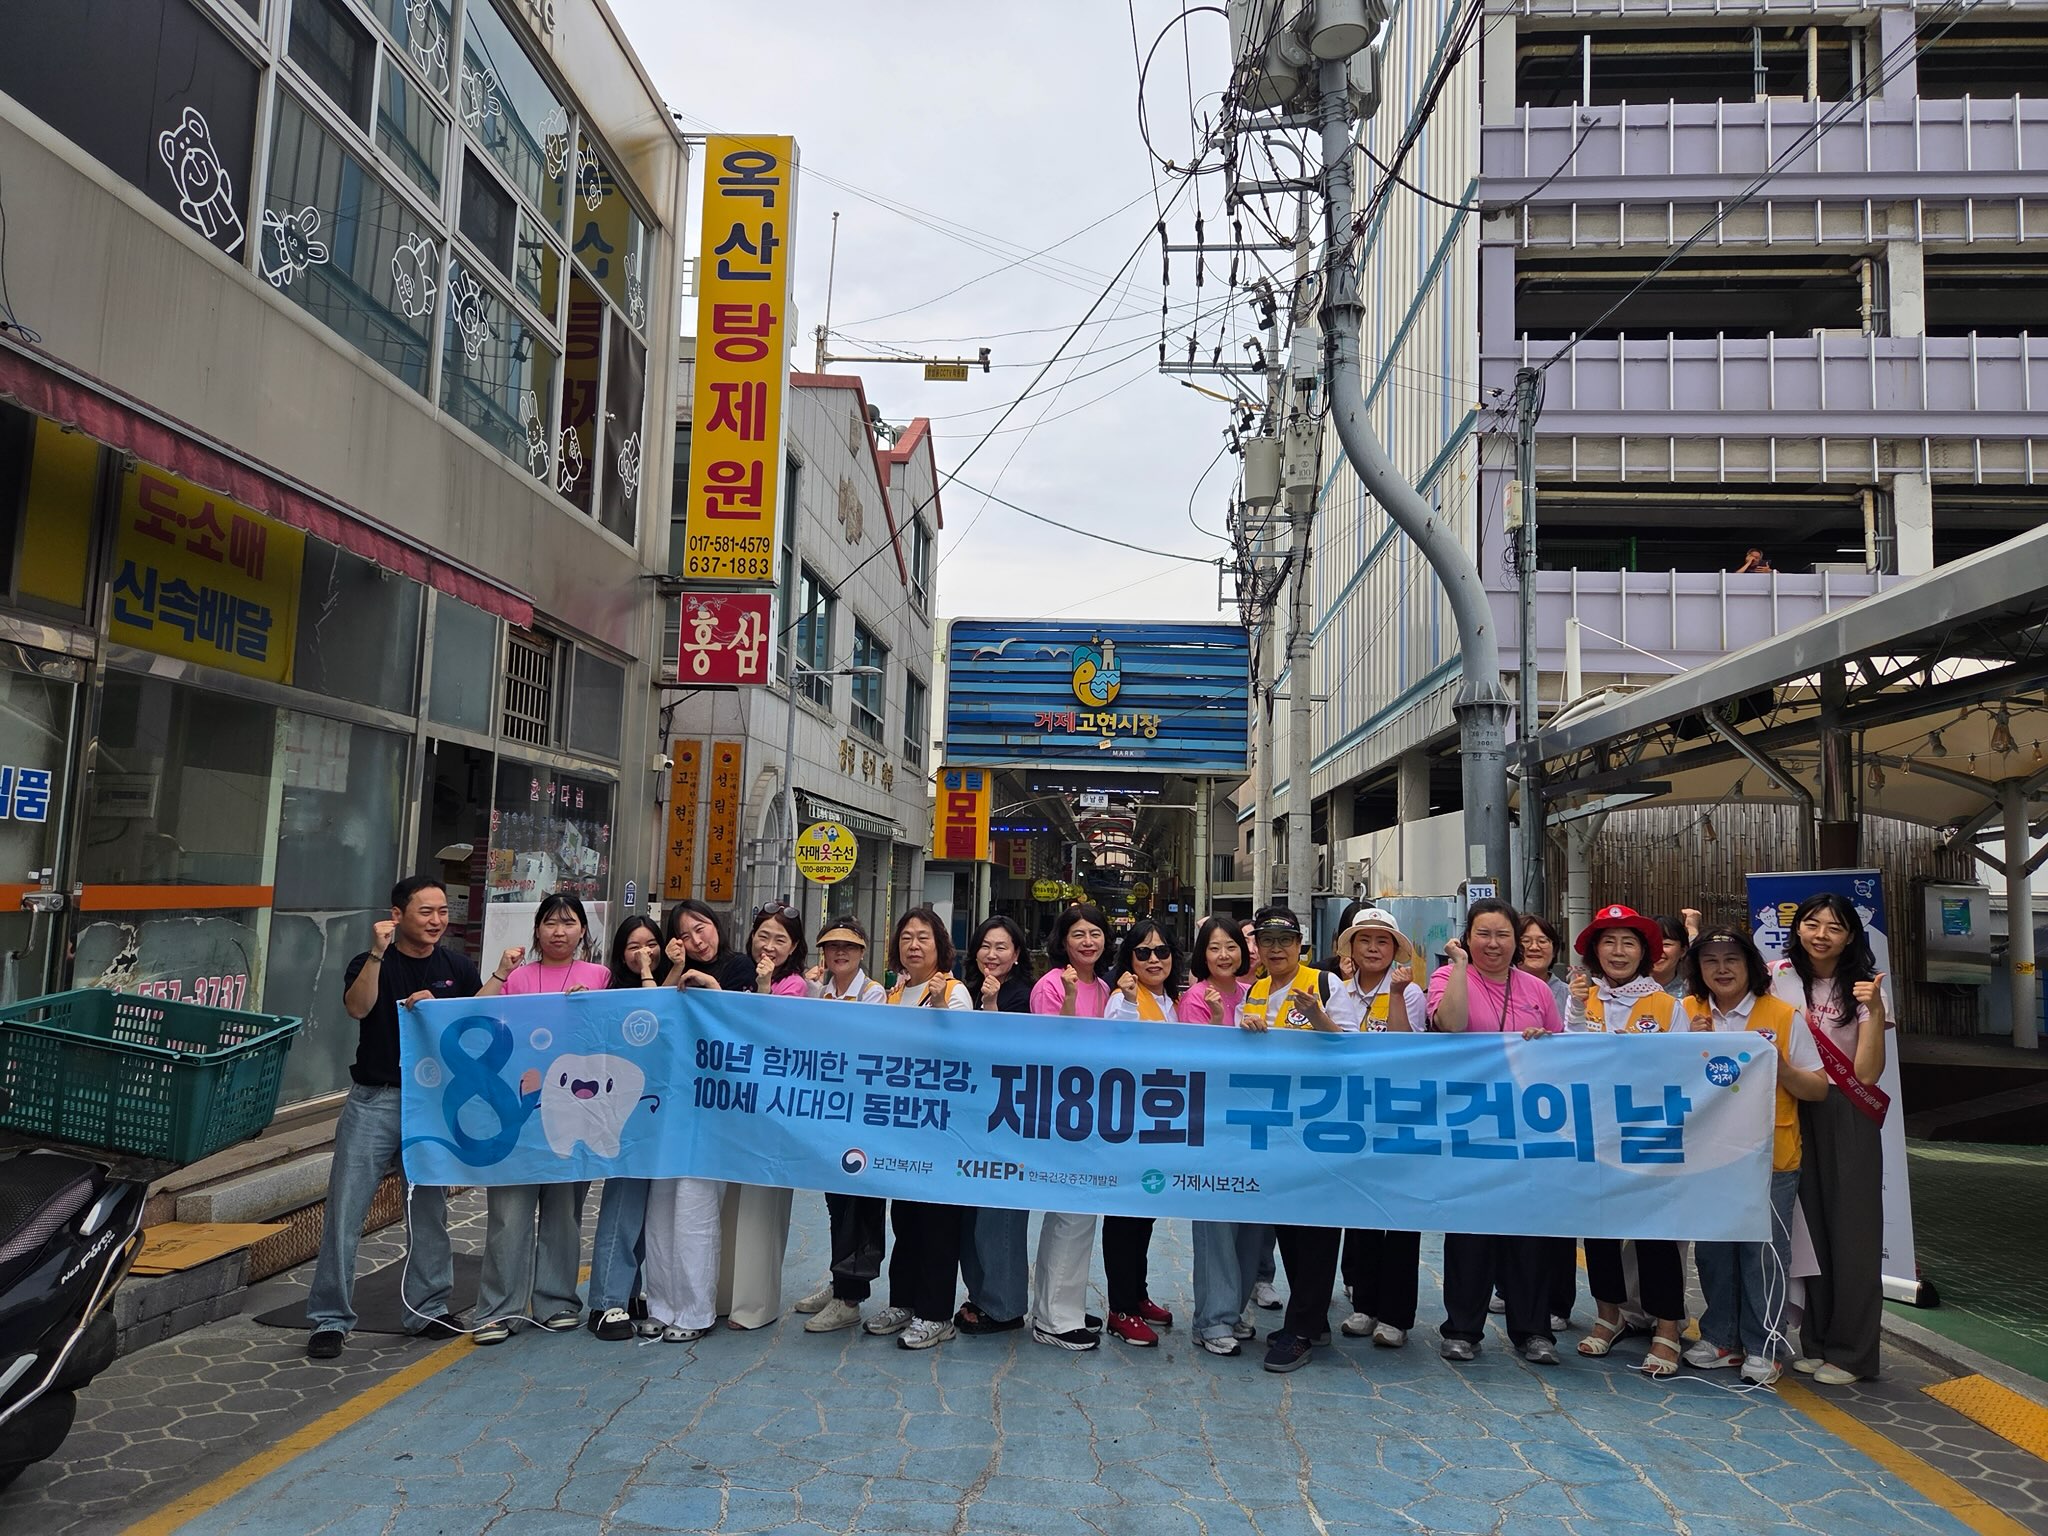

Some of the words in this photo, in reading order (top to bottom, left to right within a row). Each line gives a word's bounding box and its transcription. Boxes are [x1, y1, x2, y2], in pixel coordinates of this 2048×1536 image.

[703, 150, 780, 520] 옥산탕제원
[689, 535, 770, 554] 017-581-4579
[689, 556, 769, 575] 637-1883
[113, 559, 273, 663] 신속배달
[683, 611, 767, 678] 홍삼
[1034, 711, 1162, 739] 거제고현시장
[0, 765, 52, 823] 품
[944, 770, 983, 791] 성림
[669, 772, 689, 891] 고현분회
[709, 773, 728, 894] 성림경로당
[945, 792, 977, 860] 모텔
[798, 844, 854, 861] 자매옷수선
[802, 865, 849, 874] 010-8878-2043
[627, 893, 634, 904] 22
[1469, 887, 1492, 897] STB
[695, 1039, 754, 1073] 80년
[763, 1045, 848, 1083] 함께한
[856, 1054, 978, 1094] 구강건강,
[693, 1077, 759, 1114] 100세
[766, 1086, 854, 1123] 시대의
[863, 1093, 951, 1131] 동반자
[987, 1064, 1206, 1147] 제80회
[1225, 1073, 1595, 1162] 구강보건의
[1614, 1084, 1692, 1164] 날
[873, 1157, 933, 1175] 보건복지부
[1028, 1170, 1118, 1188] 한국건강증진개발원
[1172, 1173, 1261, 1193] 거제시보건소
